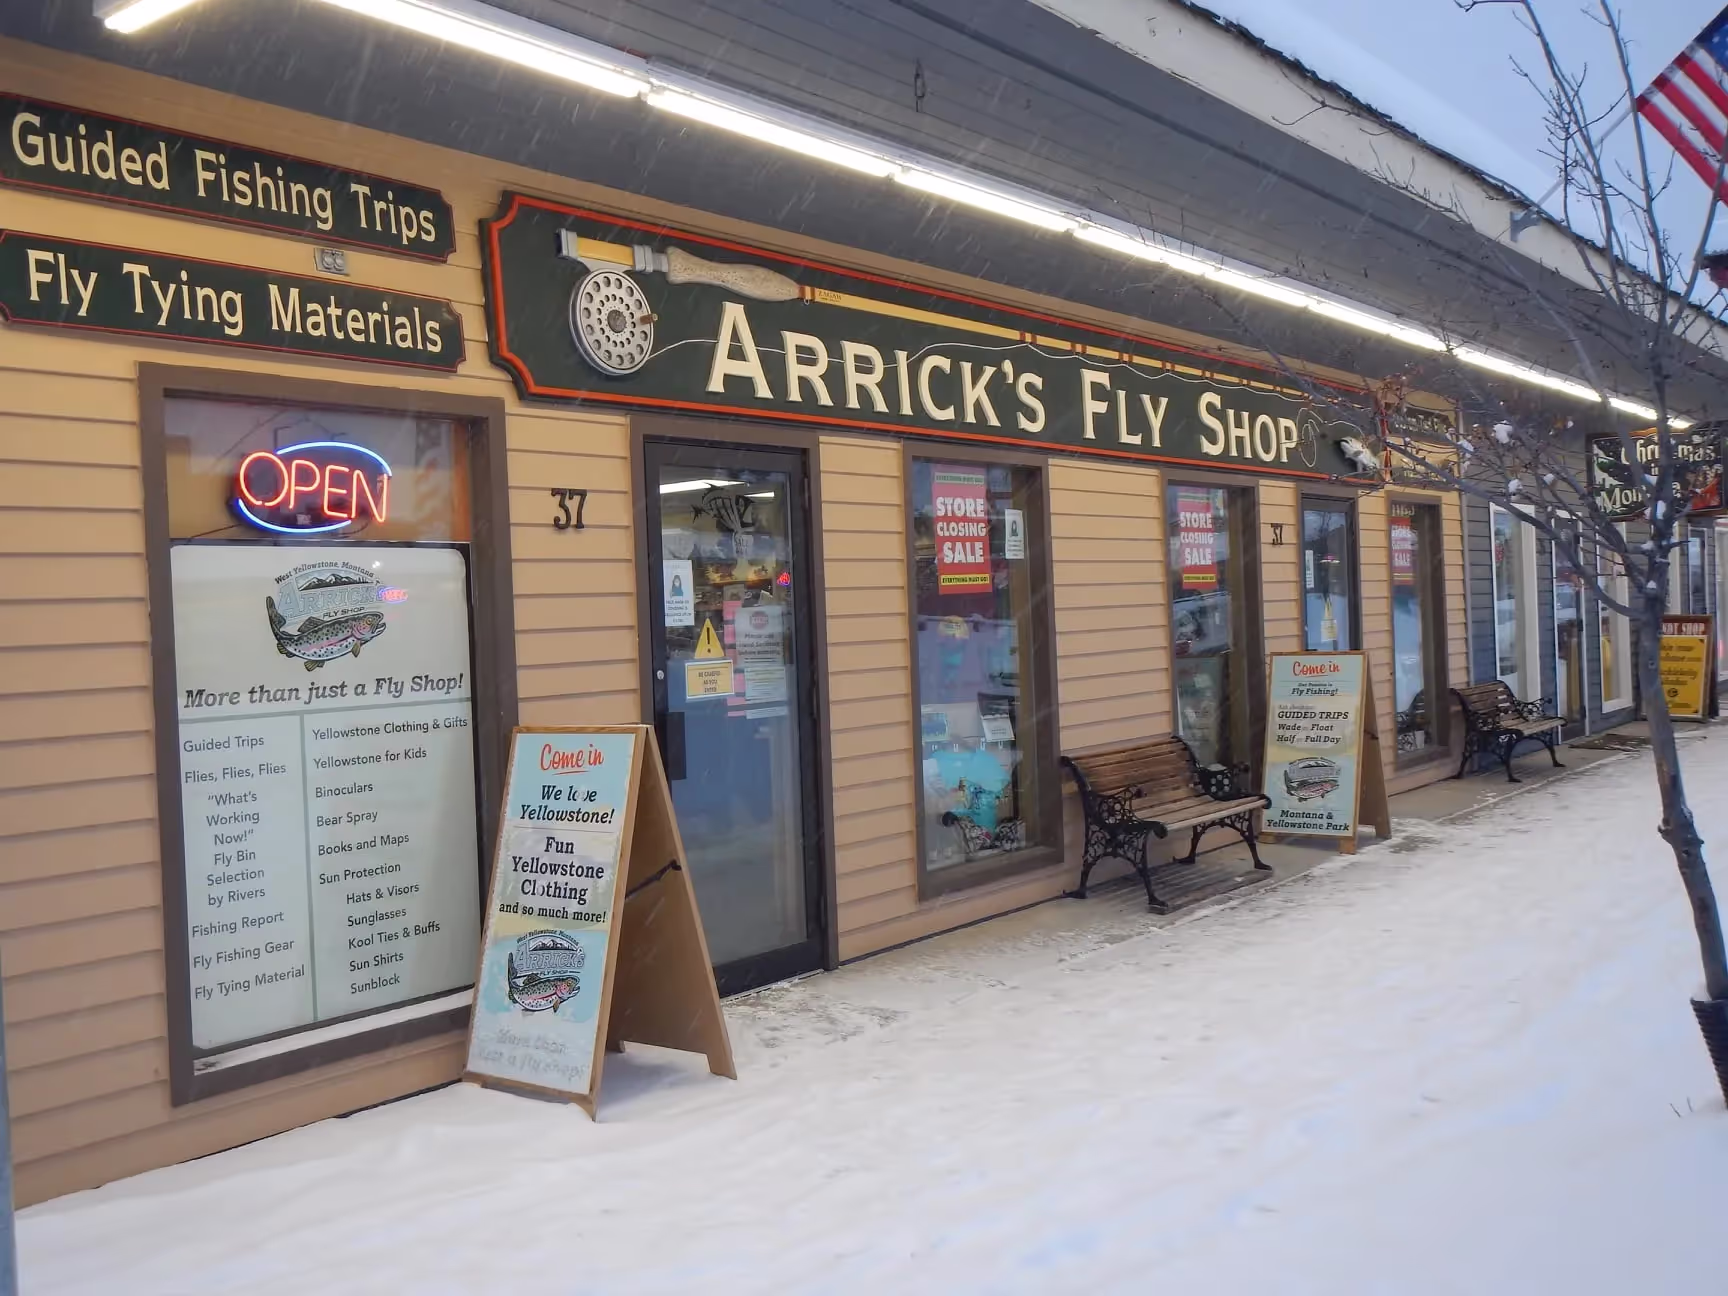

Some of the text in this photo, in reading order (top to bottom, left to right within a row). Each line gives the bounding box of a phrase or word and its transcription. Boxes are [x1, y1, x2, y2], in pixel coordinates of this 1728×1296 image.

[12, 113, 436, 244] Guided Fishing Trips
[26, 249, 442, 353] Fly Tying Materials
[706, 302, 1299, 463] ARRICK'S FLY SHOP
[240, 451, 388, 523] OPEN
[551, 488, 587, 529] 37
[936, 496, 985, 518] STORE
[937, 522, 987, 537] CLOSING
[1180, 511, 1212, 528] STORE
[1181, 531, 1214, 544] CLOSING
[943, 542, 985, 564] SALE
[1185, 548, 1212, 565] SALE
[275, 572, 293, 584] West
[341, 561, 374, 578] Montana
[322, 606, 365, 619] FLY SHOP
[1293, 660, 1340, 676] Come in
[184, 673, 464, 709] More than just a Fly Shop!
[1291, 687, 1338, 696] Fly Fishing!
[1277, 711, 1349, 720] GUIDED TRIPS
[312, 715, 468, 741] Yellowstone Clothing & Gifts
[1278, 723, 1301, 731] Wade
[1310, 723, 1333, 731] Float
[183, 736, 265, 753] Guided Trips
[1277, 735, 1297, 744] Half
[1304, 735, 1322, 743] Full
[1323, 735, 1341, 744] Day
[313, 747, 427, 769] Yellowstone for Kids
[540, 743, 604, 771] Come in
[184, 762, 286, 783] Flies, Flies, Flies
[208, 790, 258, 806] "What's
[315, 782, 373, 798] Binoculars
[541, 785, 562, 801] We
[206, 811, 260, 827] Working
[316, 811, 378, 827] Bear Spray
[519, 804, 615, 825] Yellowstone!
[1280, 809, 1334, 819] Montana &
[1267, 819, 1350, 831] Yellowstone Park
[214, 829, 254, 845] Now!"
[318, 833, 410, 856] Books and Maps
[544, 836, 575, 854] Fun
[214, 849, 256, 867] Fly Bin
[512, 856, 604, 879] Yellowstone
[207, 869, 265, 886] Selection
[319, 862, 401, 885] Sun Protection
[208, 888, 265, 908] by Rivers
[346, 883, 420, 904] Hats & Visors
[347, 908, 407, 927] Sunglasses
[499, 902, 606, 923] and so much more!
[192, 911, 285, 938] Fishing Report
[348, 920, 441, 950] Kool Ties & Buffs
[193, 939, 295, 970] Fly Fishing Gear
[349, 952, 404, 972] Sun Shirts
[195, 964, 305, 1000] Fly Tying Material
[350, 973, 401, 994] Sunblock
